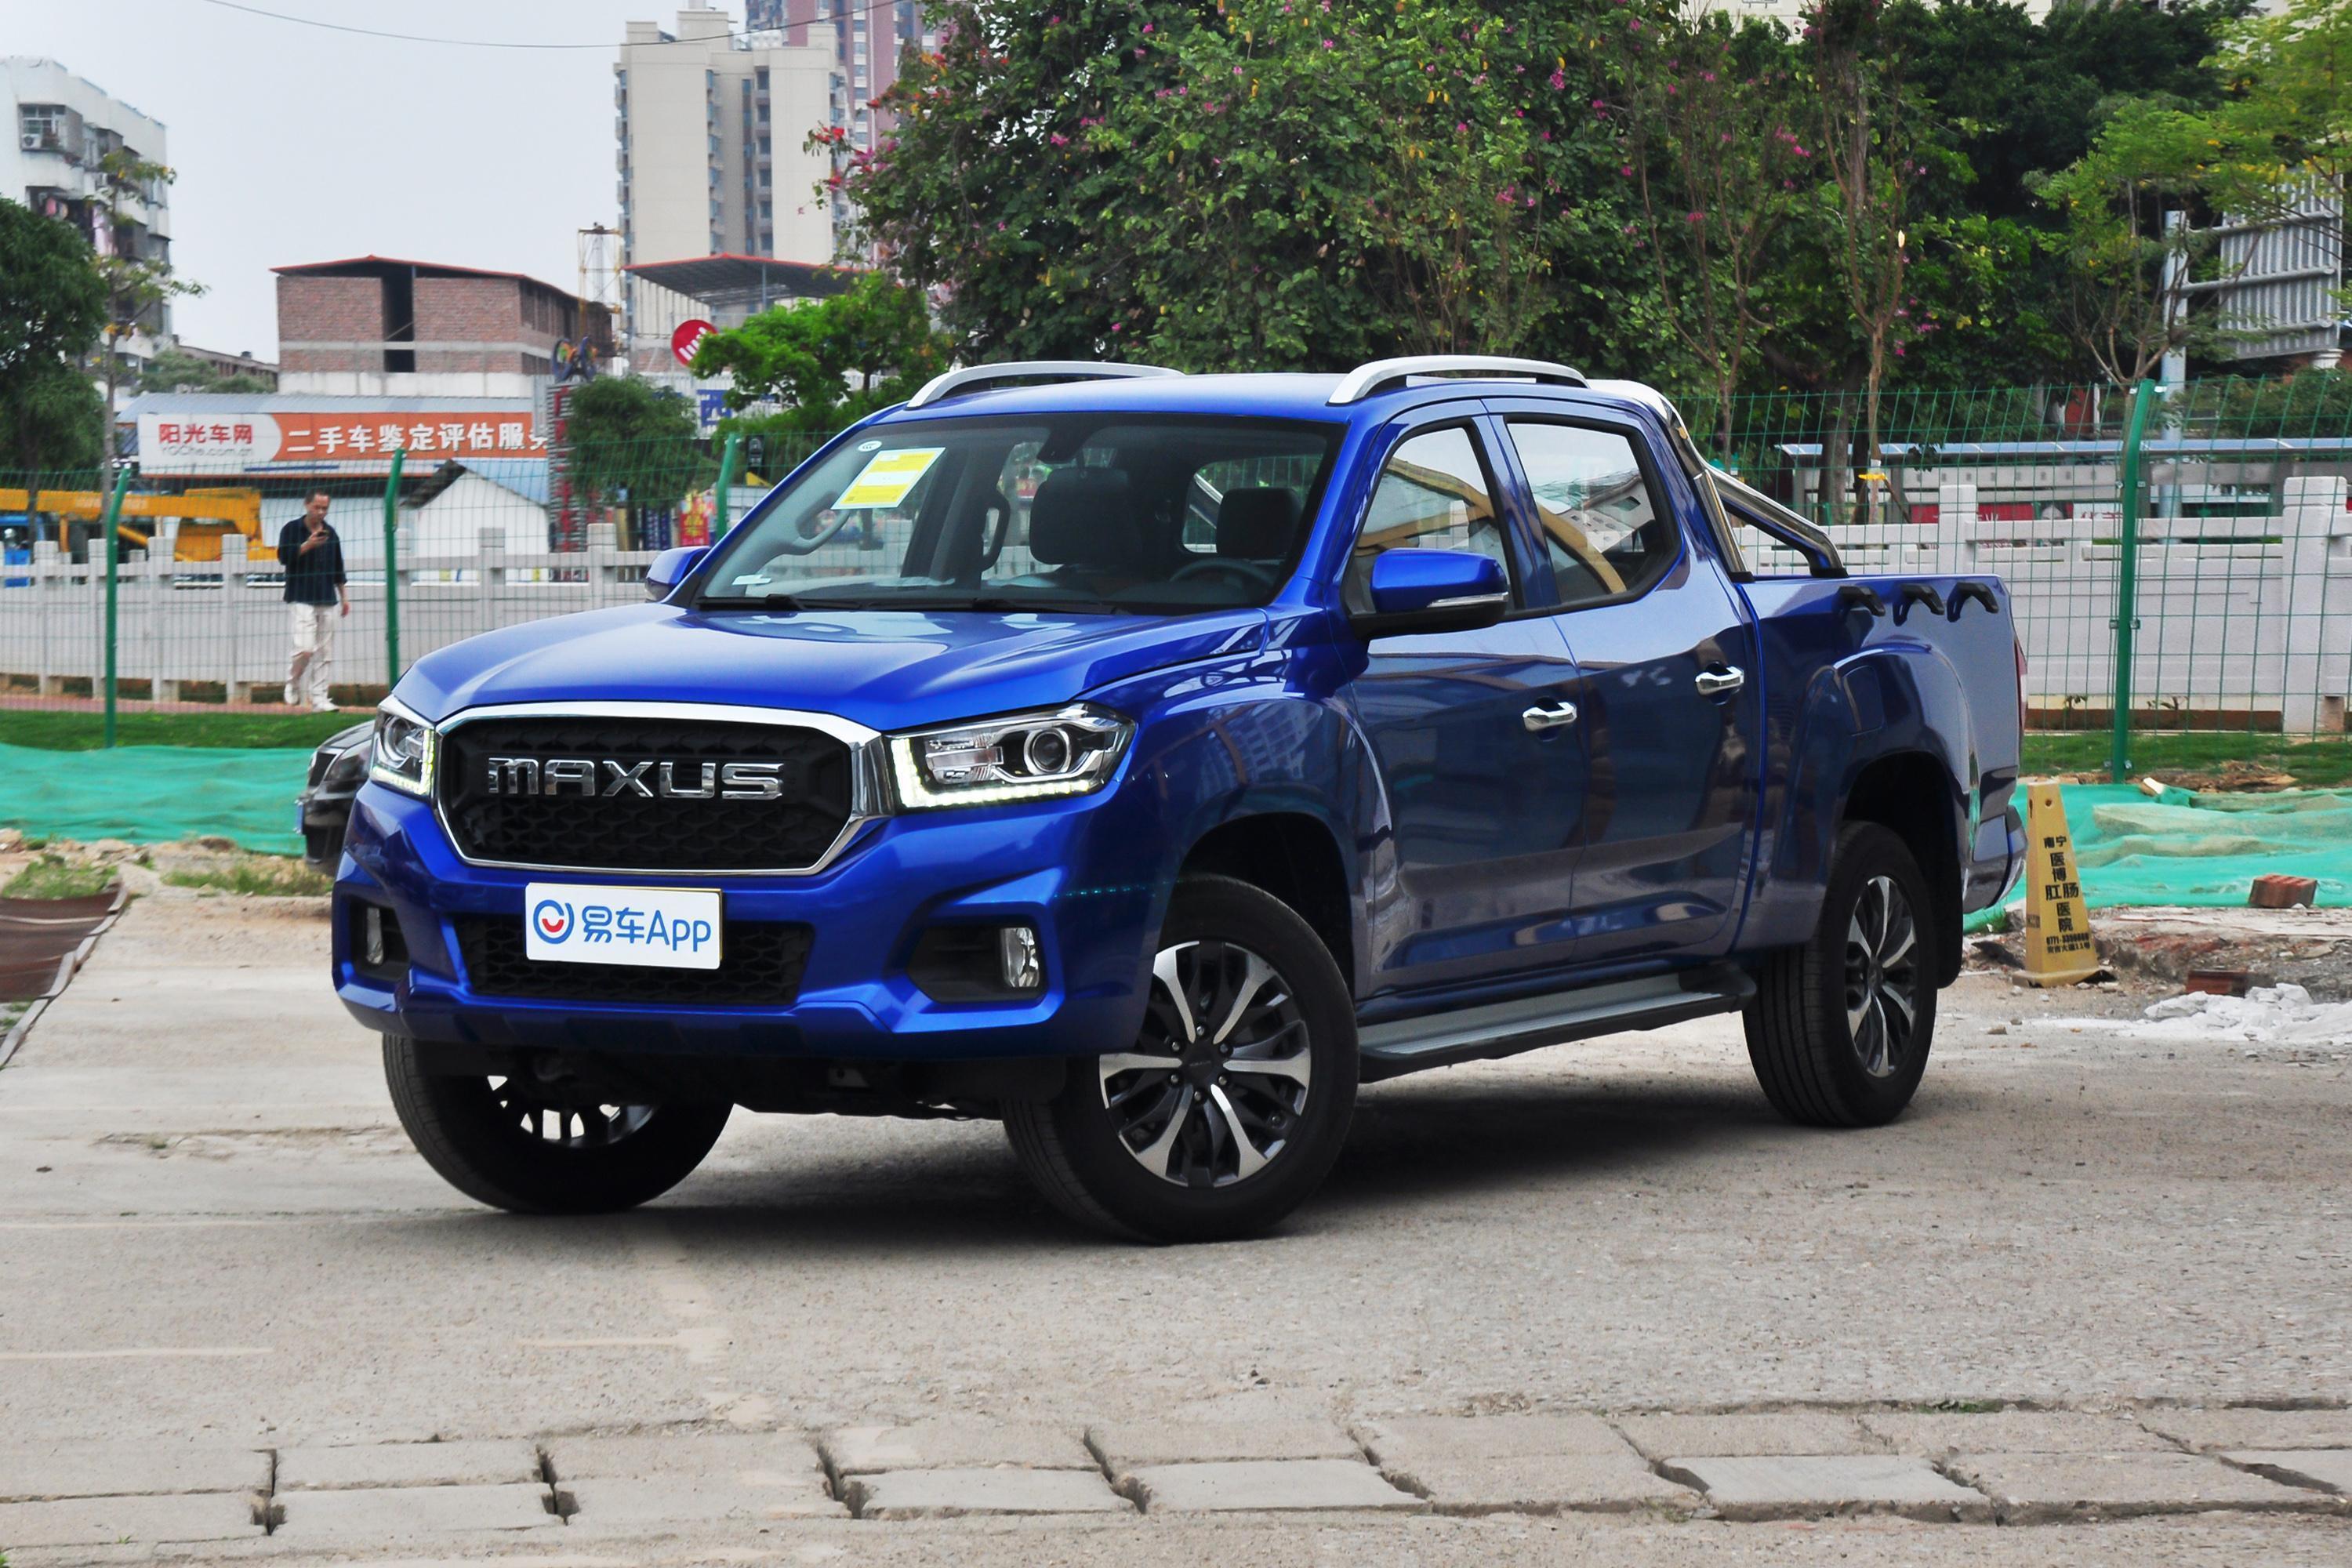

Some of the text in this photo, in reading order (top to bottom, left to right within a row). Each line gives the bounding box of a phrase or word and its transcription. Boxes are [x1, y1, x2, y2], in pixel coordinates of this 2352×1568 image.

[158, 423, 252, 445] 阳光车网
[488, 757, 785, 800] MAXUS
[2044, 836, 2067, 848] 南宁
[2045, 883, 2078, 900] 肛肠
[581, 905, 711, 952] 易车App
[2056, 902, 2073, 932] 医院
